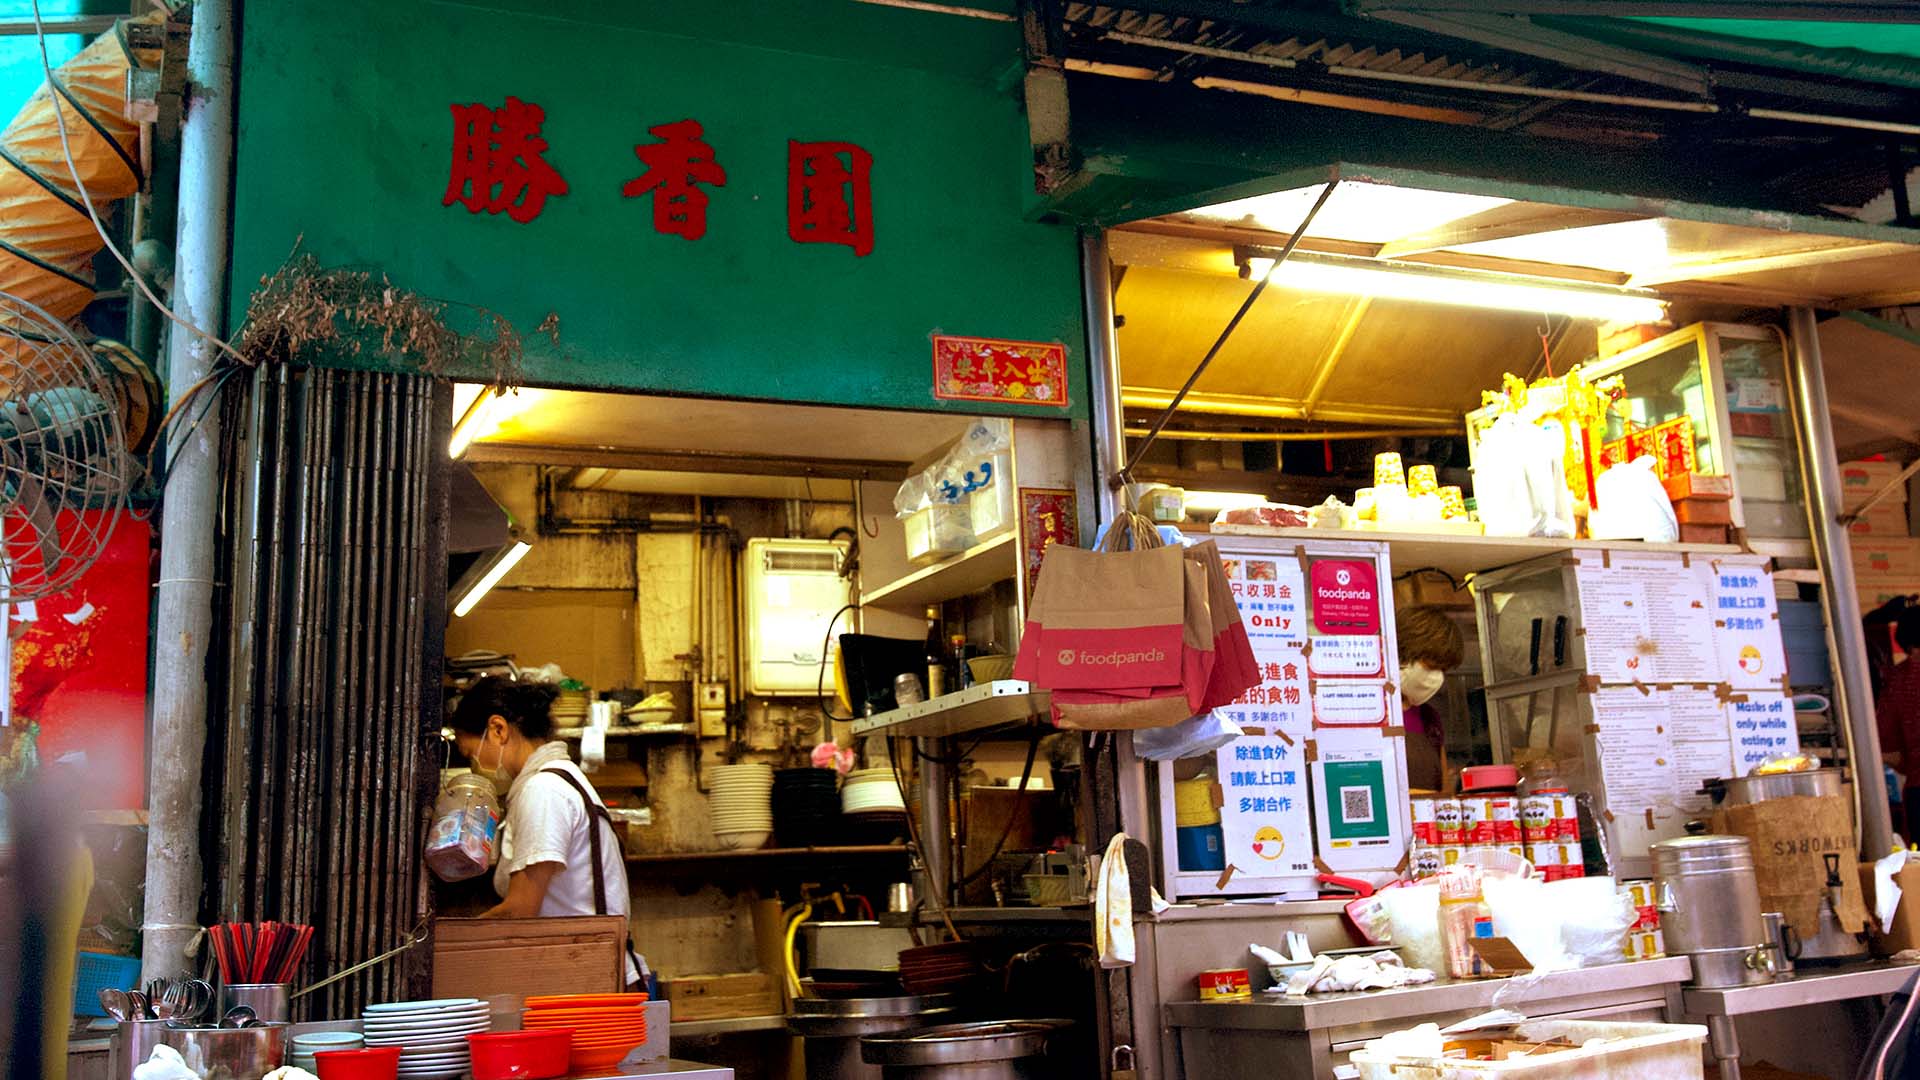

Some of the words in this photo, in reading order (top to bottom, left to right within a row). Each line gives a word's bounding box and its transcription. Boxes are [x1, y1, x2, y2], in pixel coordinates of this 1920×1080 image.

[442, 95, 874, 257] 勝香園
[1231, 583, 1292, 599] 只收現金
[1318, 587, 1371, 601] foodpanda
[1251, 615, 1291, 630] Only
[1080, 648, 1164, 667] foodpanda
[1257, 662, 1298, 681] 進食
[1736, 701, 1767, 712] Masks
[1768, 701, 1782, 712] off
[1736, 718, 1757, 731] only
[1759, 718, 1787, 729] while
[1741, 735, 1773, 747] eating
[1775, 737, 1786, 745] or
[1235, 745, 1288, 761] 除進食外
[1230, 770, 1296, 787] 請戴上口罩
[1239, 797, 1292, 813] 多謝合作
